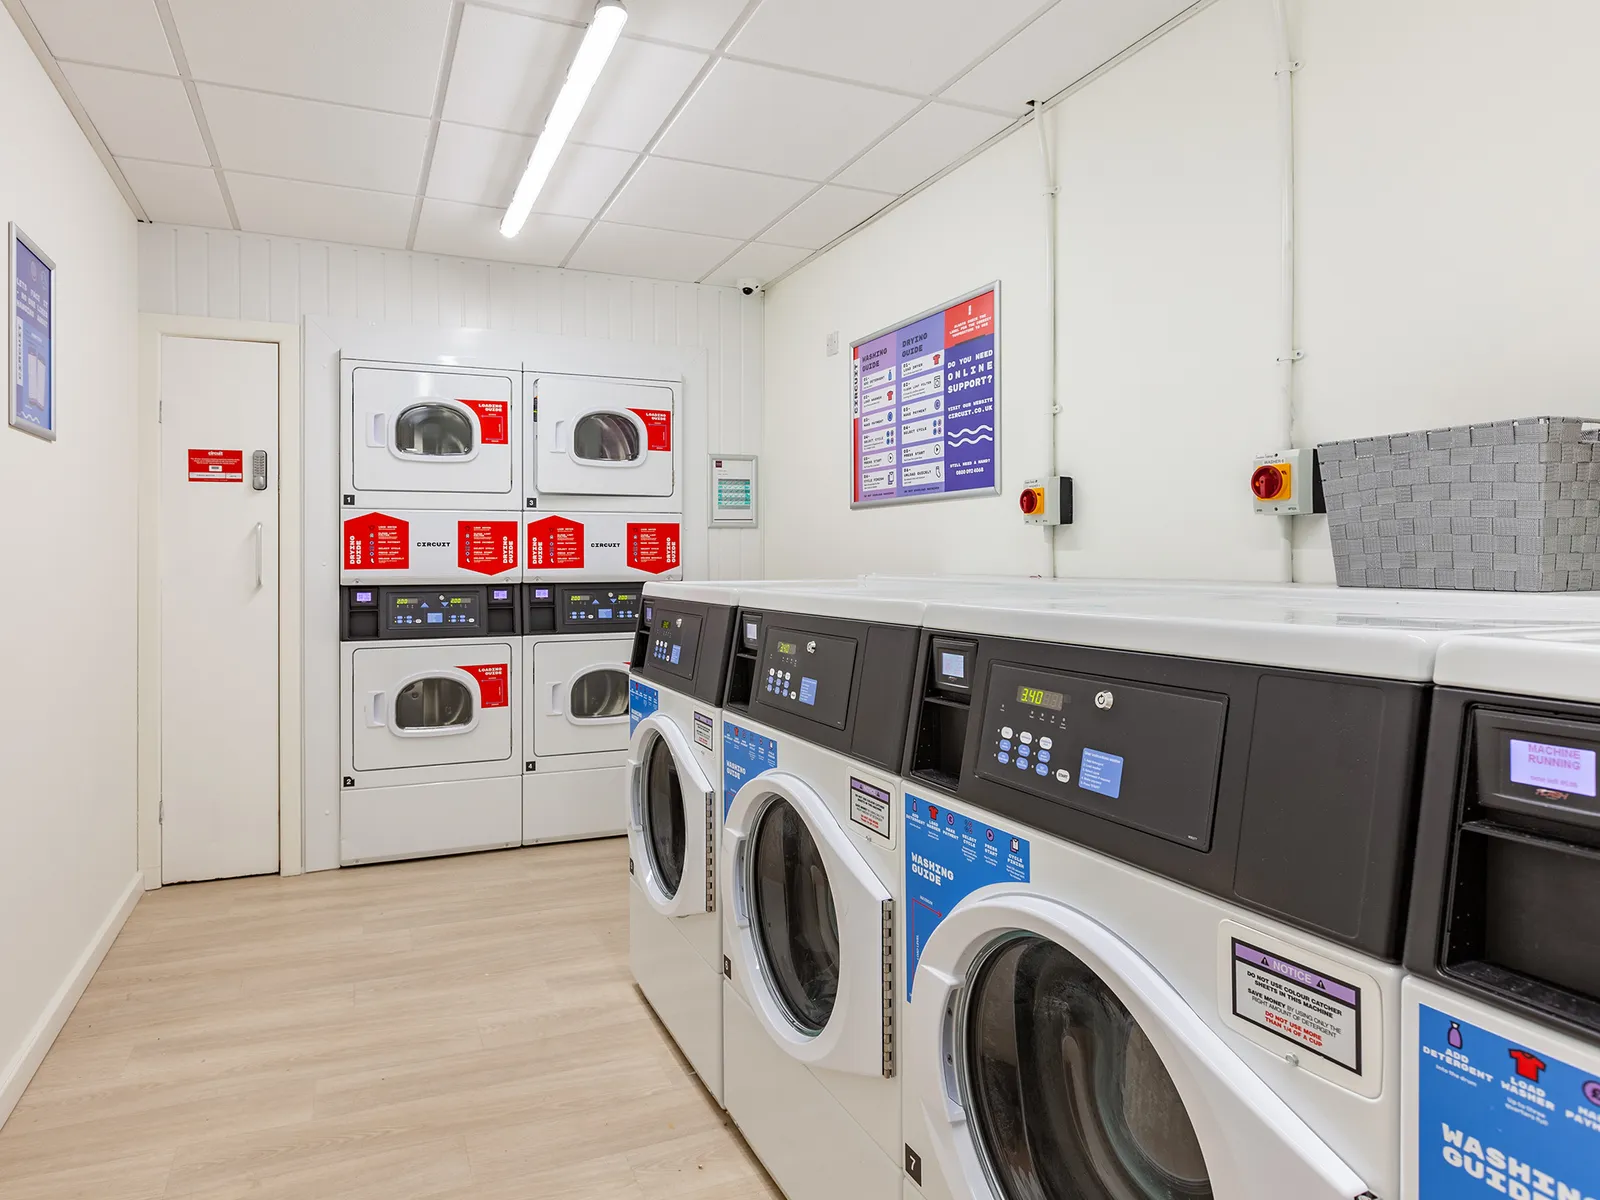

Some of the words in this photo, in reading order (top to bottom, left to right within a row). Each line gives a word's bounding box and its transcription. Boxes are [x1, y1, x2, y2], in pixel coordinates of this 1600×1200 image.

[902, 332, 928, 348] DRYING
[862, 348, 888, 362] WASHING
[902, 344, 924, 358] GUIDE
[947, 361, 956, 369] DO
[959, 356, 972, 365] YOU
[975, 349, 993, 360] NEED
[862, 360, 880, 372] GUIDE
[947, 360, 993, 381] ONLINE
[947, 374, 993, 394] SUPPORT?
[972, 397, 993, 406] WEBSITE
[947, 404, 993, 420] CIRCUIT.CO.UK
[1020, 688, 1044, 705] 3.40
[1528, 744, 1580, 760] MACHINE
[1528, 754, 1580, 770] RUNNING
[727, 760, 746, 775] WASHING
[727, 767, 741, 780] GUIDE
[984, 843, 998, 852] PRESS
[984, 848, 998, 857] START
[911, 852, 954, 881] WASHING
[911, 864, 942, 886] GUIDE
[1273, 960, 1312, 984] NOTICE
[1254, 980, 1278, 994] SHEETS
[1287, 994, 1302, 1005] THIS
[1303, 1001, 1333, 1019] MACHINE
[1256, 973, 1270, 984] NOT
[1270, 980, 1283, 990] USE
[1284, 987, 1310, 1002] COLOUR
[1311, 998, 1342, 1016] CATCHER
[1248, 988, 1263, 999] SAVE
[1264, 994, 1286, 1008] MONEY
[1295, 1008, 1313, 1020] USING
[1313, 1015, 1330, 1028] ONLY
[1330, 1024, 1342, 1034] THE
[1252, 996, 1268, 1008] RIGHT
[1268, 1003, 1292, 1017] AMOUNT
[1301, 1018, 1337, 1038] DETERGENT
[1265, 1010, 1273, 1018] DO
[1274, 1014, 1288, 1025] NOT
[1289, 1021, 1302, 1031] USE
[1303, 1028, 1323, 1041] MORE
[1265, 1016, 1282, 1028] THAN
[1283, 1024, 1292, 1034] 1/4
[1293, 1029, 1302, 1037] OF
[1309, 1037, 1323, 1047] CUP
[1423, 1045, 1494, 1082] DETERGENT
[1445, 1048, 1469, 1064] ADD
[1500, 1080, 1556, 1111] WASHER
[1510, 1076, 1546, 1098] LOAD
[910, 1155, 916, 1170] 7
[1442, 1122, 1598, 1200] WASHIN
